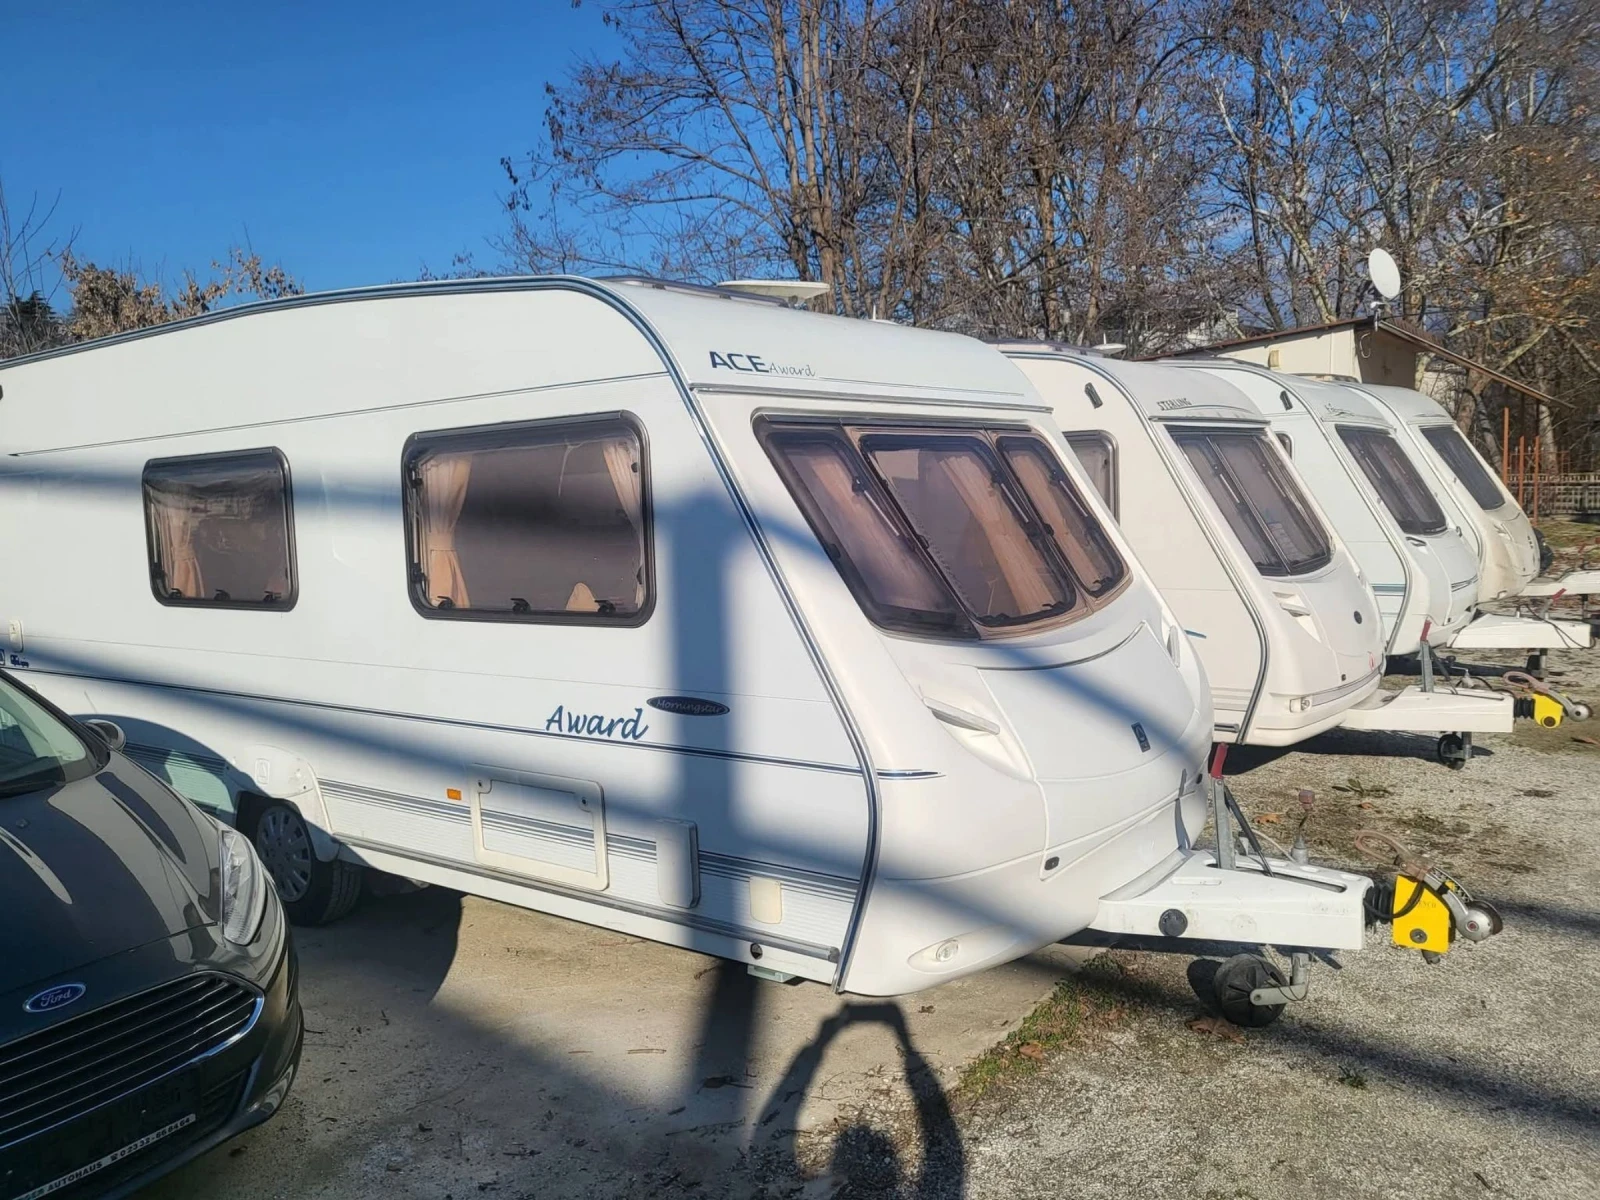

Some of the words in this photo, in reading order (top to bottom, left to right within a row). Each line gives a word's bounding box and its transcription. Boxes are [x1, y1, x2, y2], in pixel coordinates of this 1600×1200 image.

[709, 351, 769, 373] ACE
[769, 362, 816, 377] Award
[1156, 398, 1192, 411] STERLING
[655, 698, 722, 714] Morningstar
[545, 704, 649, 741] Award
[40, 989, 72, 1007] Ford
[47, 1161, 103, 1193] AUTOHAUS
